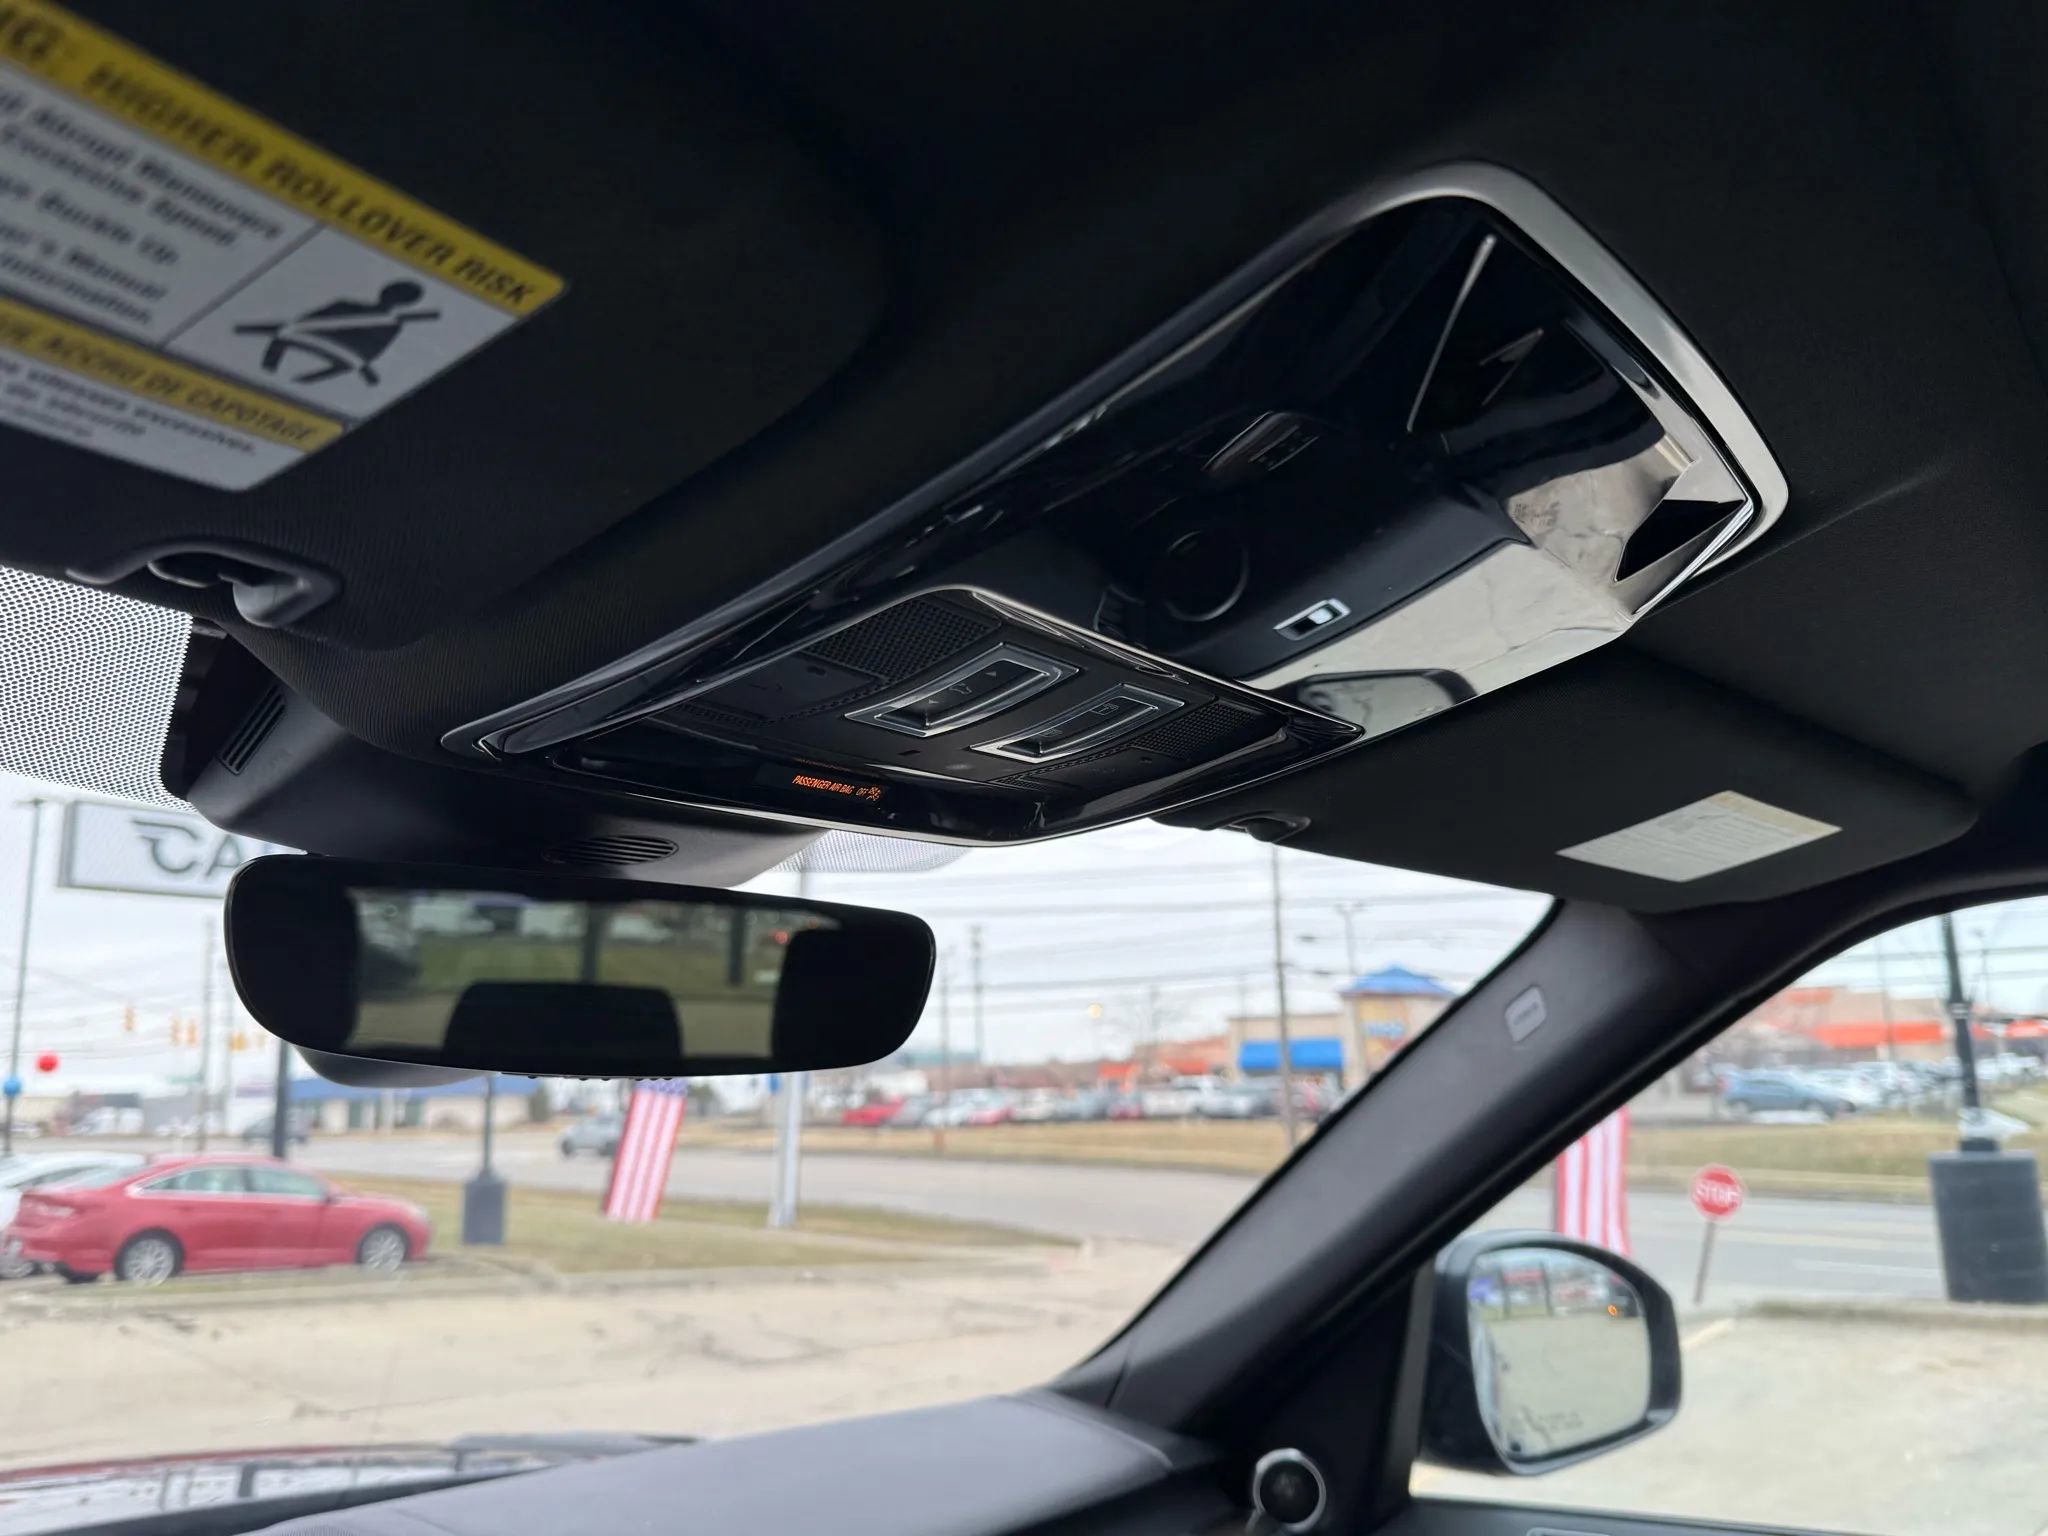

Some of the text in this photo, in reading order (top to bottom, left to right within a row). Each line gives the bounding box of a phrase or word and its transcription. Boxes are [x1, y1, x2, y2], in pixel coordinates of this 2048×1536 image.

[84, 62, 262, 169] HIGHER
[262, 157, 456, 267] ROLLOVER
[453, 255, 535, 306] RISK
[184, 386, 318, 444] CAPOTAGE
[792, 775, 869, 796] PASSENGER AIR BAG OFF
[1696, 1179, 1742, 1207] STOP
